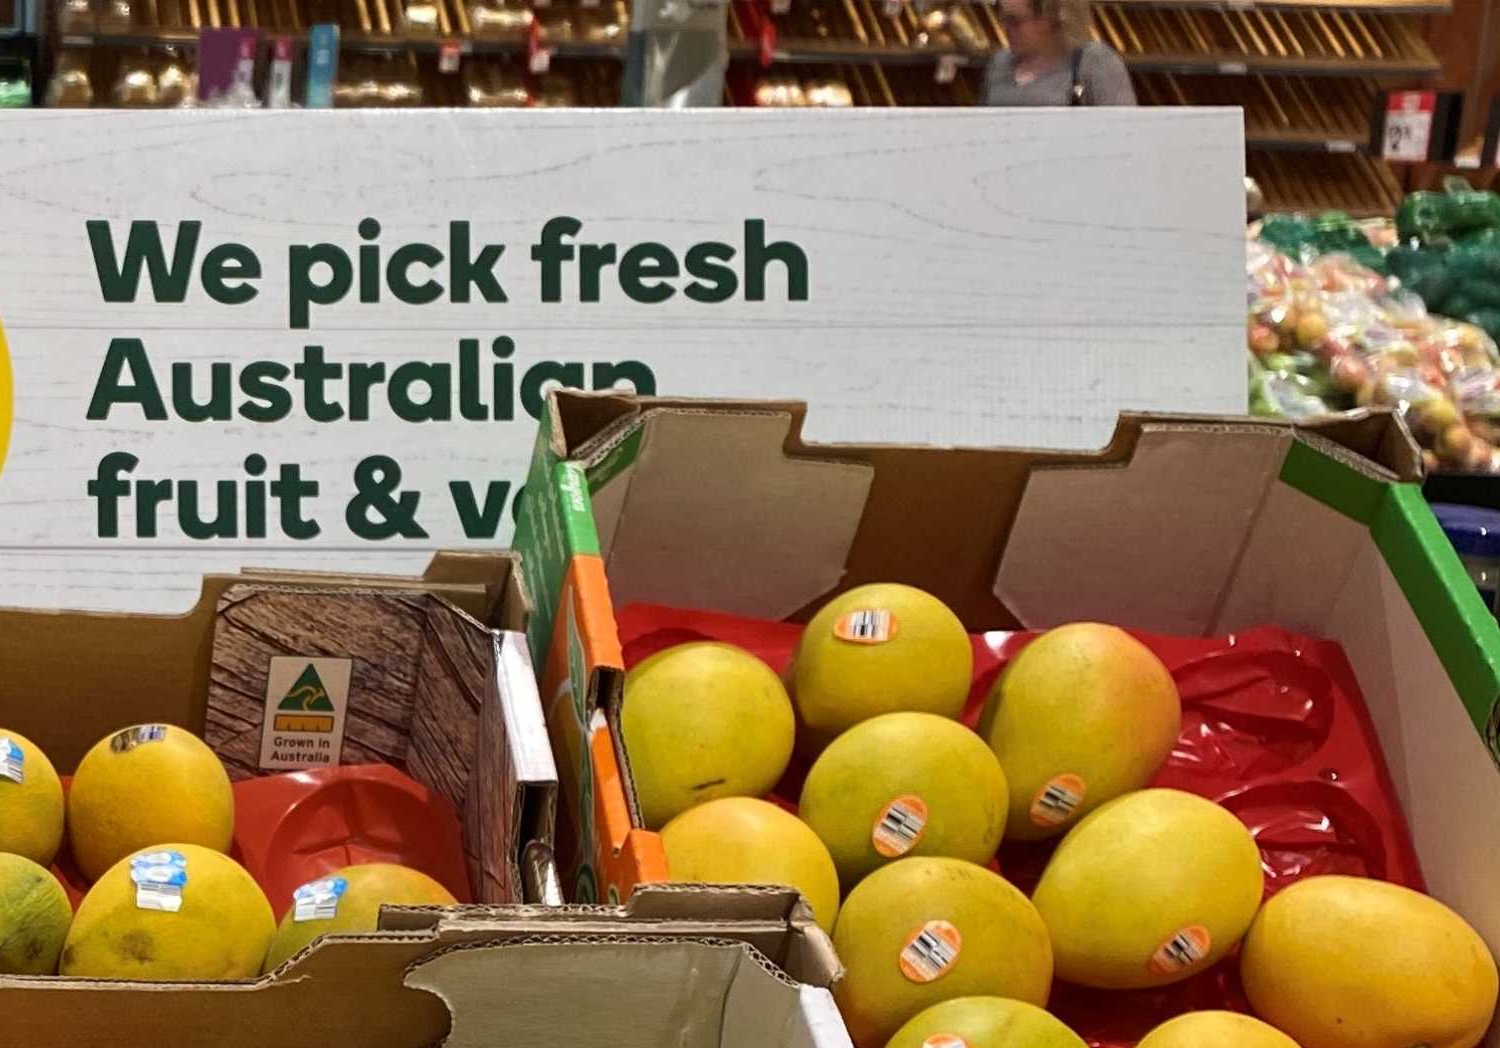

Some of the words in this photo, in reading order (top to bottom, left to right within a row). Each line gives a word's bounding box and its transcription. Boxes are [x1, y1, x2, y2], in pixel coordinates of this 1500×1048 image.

[86, 219, 262, 304] We
[288, 217, 508, 329] pick
[531, 216, 809, 304] fresh
[86, 336, 656, 422] Australian
[87, 451, 322, 540] fruit
[345, 454, 431, 540] &
[270, 751, 330, 763] Australia
[274, 737, 314, 747] Grown
